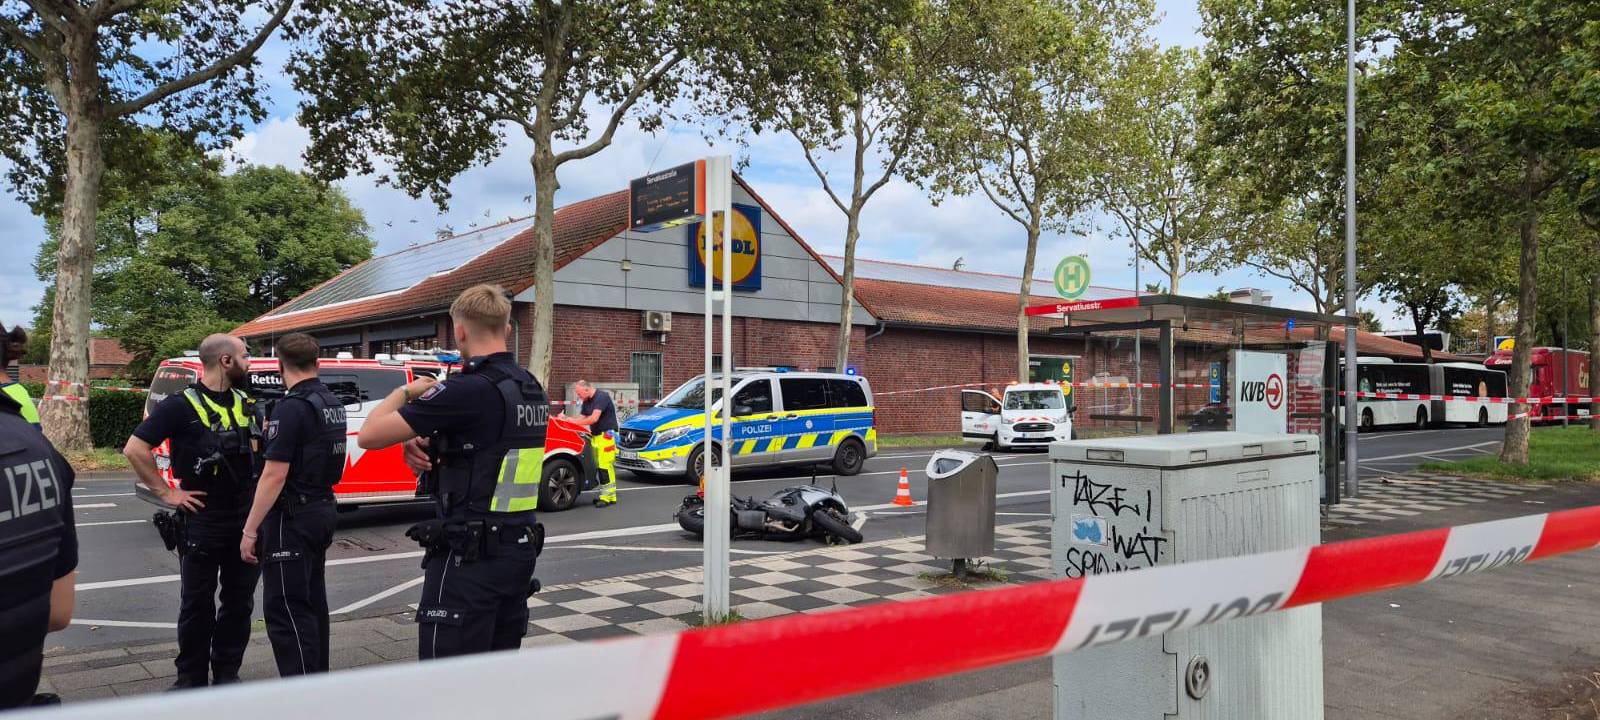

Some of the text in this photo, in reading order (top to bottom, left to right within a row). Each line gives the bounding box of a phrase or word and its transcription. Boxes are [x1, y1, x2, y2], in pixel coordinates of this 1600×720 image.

[701, 235, 755, 255] LDL
[1056, 301, 1103, 313] Servatiusstr.
[1240, 381, 1266, 402] KVB
[741, 424, 772, 435] POLIZEI
